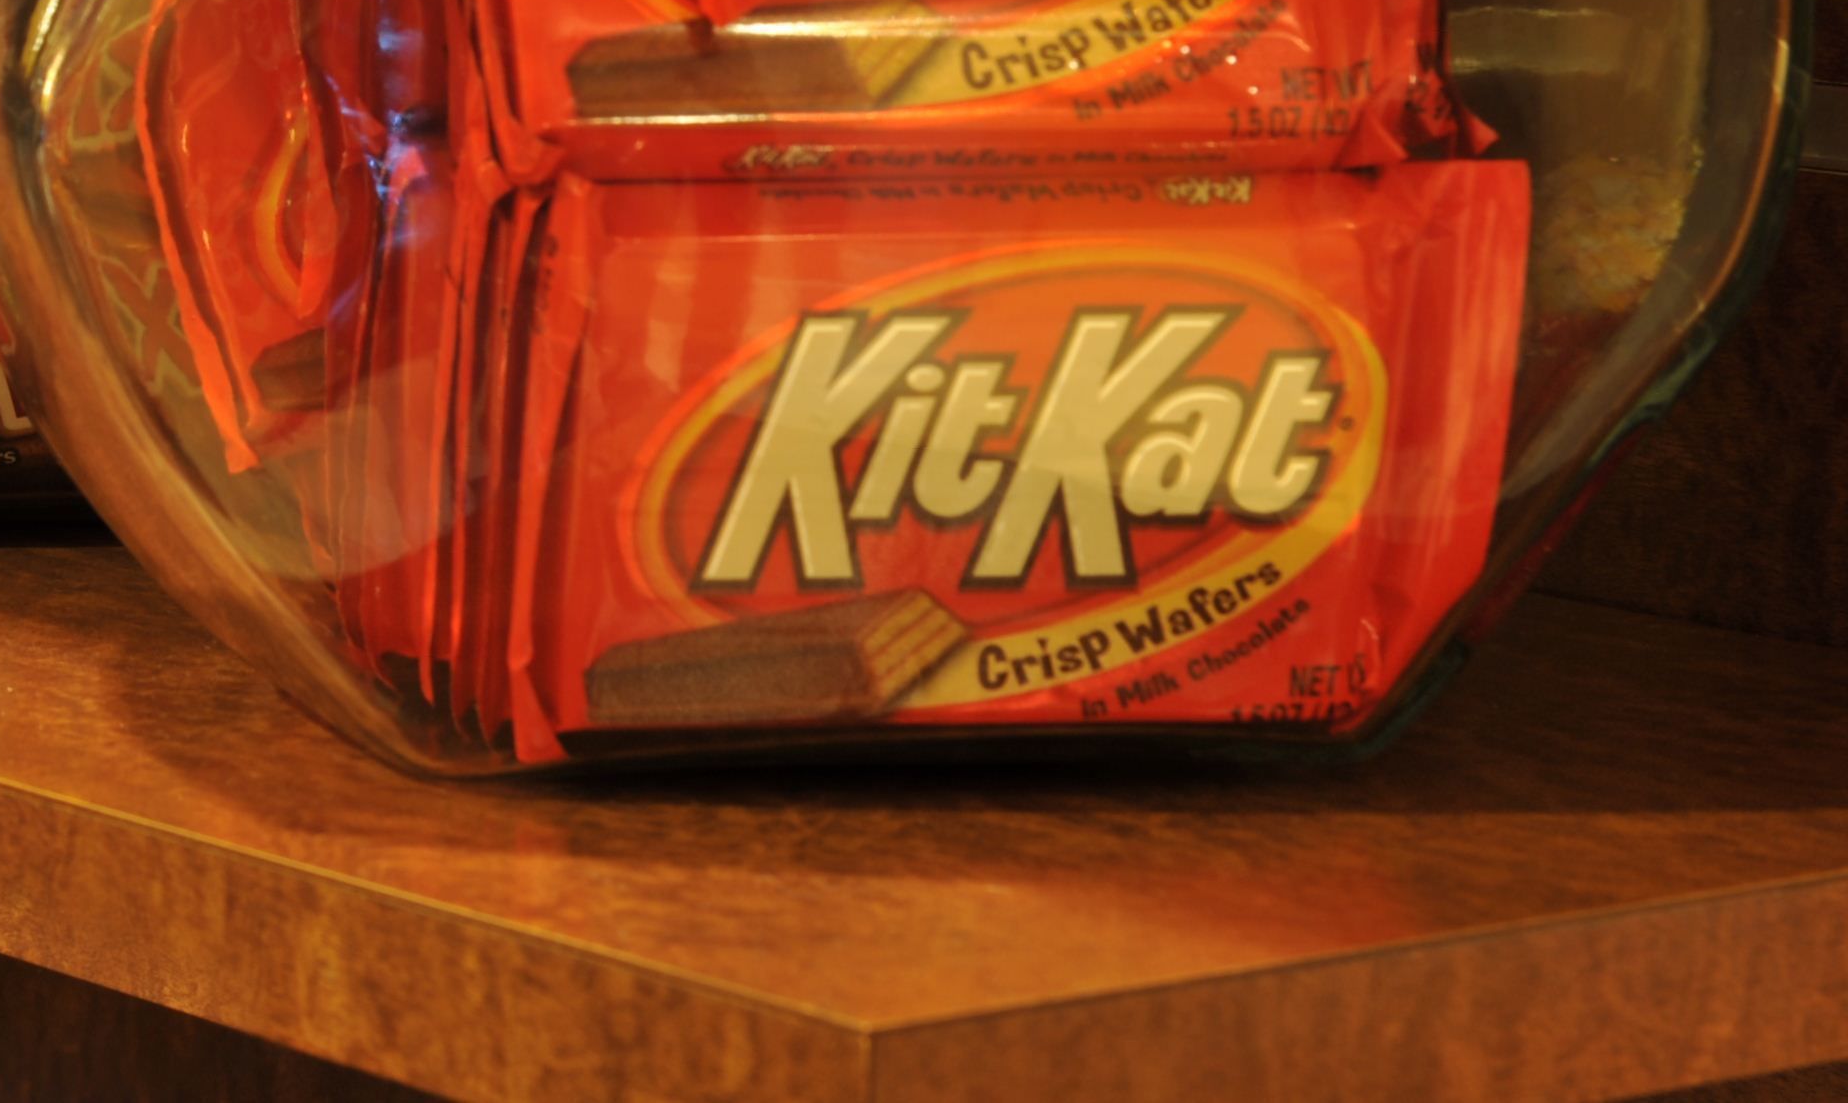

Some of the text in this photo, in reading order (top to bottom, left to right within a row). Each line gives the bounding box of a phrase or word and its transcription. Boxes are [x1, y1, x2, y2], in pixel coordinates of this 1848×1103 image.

[960, 26, 1092, 92] Crisp
[1106, 70, 1170, 111] Milk
[976, 559, 1284, 691] Crisp Wafers
[1114, 670, 1181, 710] Milk
[1186, 597, 1313, 683] Chocolate
[1288, 665, 1342, 698] NET
